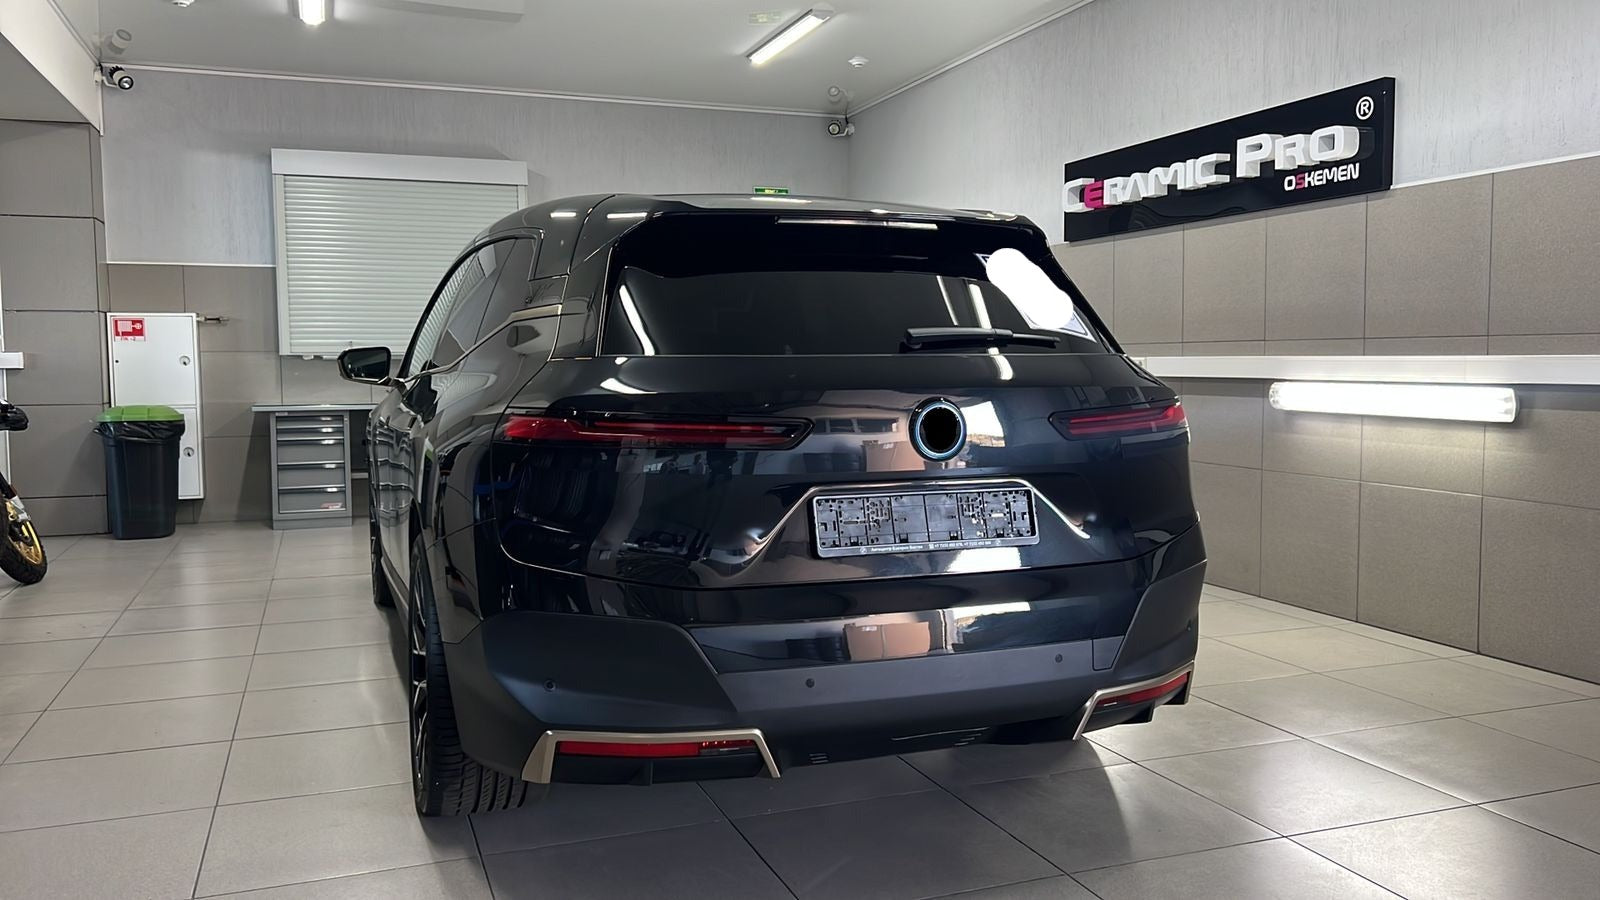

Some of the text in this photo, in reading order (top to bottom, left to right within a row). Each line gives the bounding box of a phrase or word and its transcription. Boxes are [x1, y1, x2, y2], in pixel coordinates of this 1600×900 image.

[1063, 125, 1360, 213] CERAMIC PRO
[1284, 162, 1360, 192] OSKEMEN
